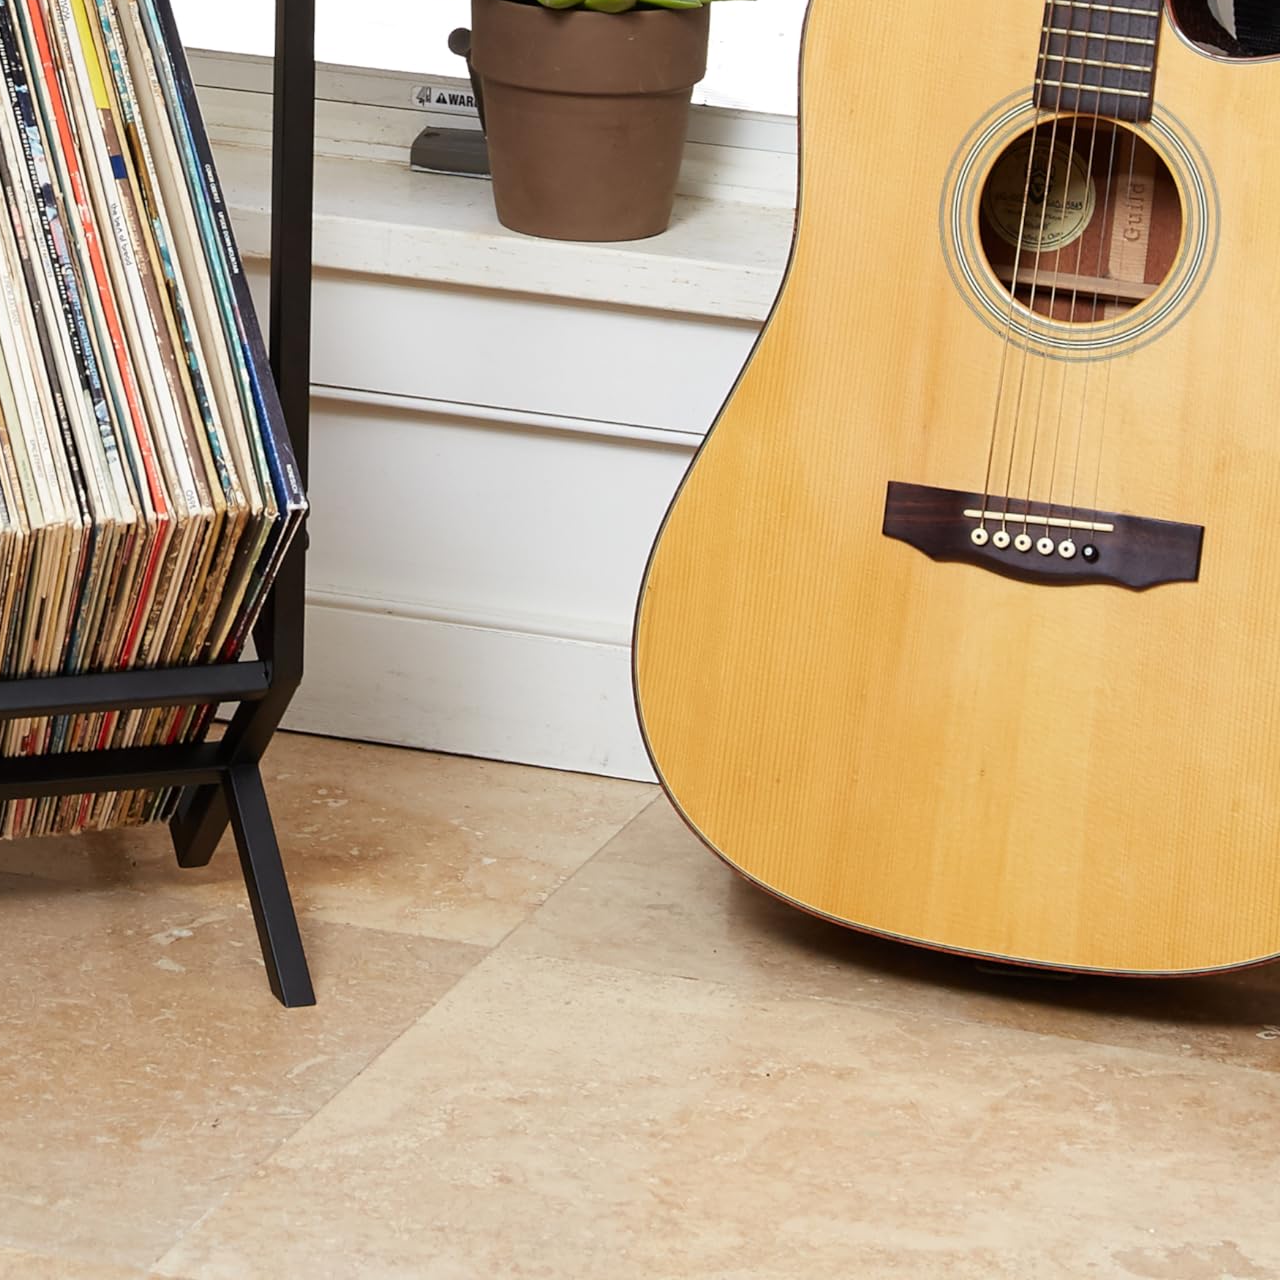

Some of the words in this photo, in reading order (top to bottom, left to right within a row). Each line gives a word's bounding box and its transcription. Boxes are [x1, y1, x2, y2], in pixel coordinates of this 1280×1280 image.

[205, 164, 214, 181] CONOR
[110, 203, 119, 215] the
[121, 244, 132, 265] bread
[217, 211, 226, 229] UPSIDE
[222, 230, 231, 246] DOWN
[227, 247, 238, 273] MOUNTAIN
[1122, 181, 1146, 243] Guild
